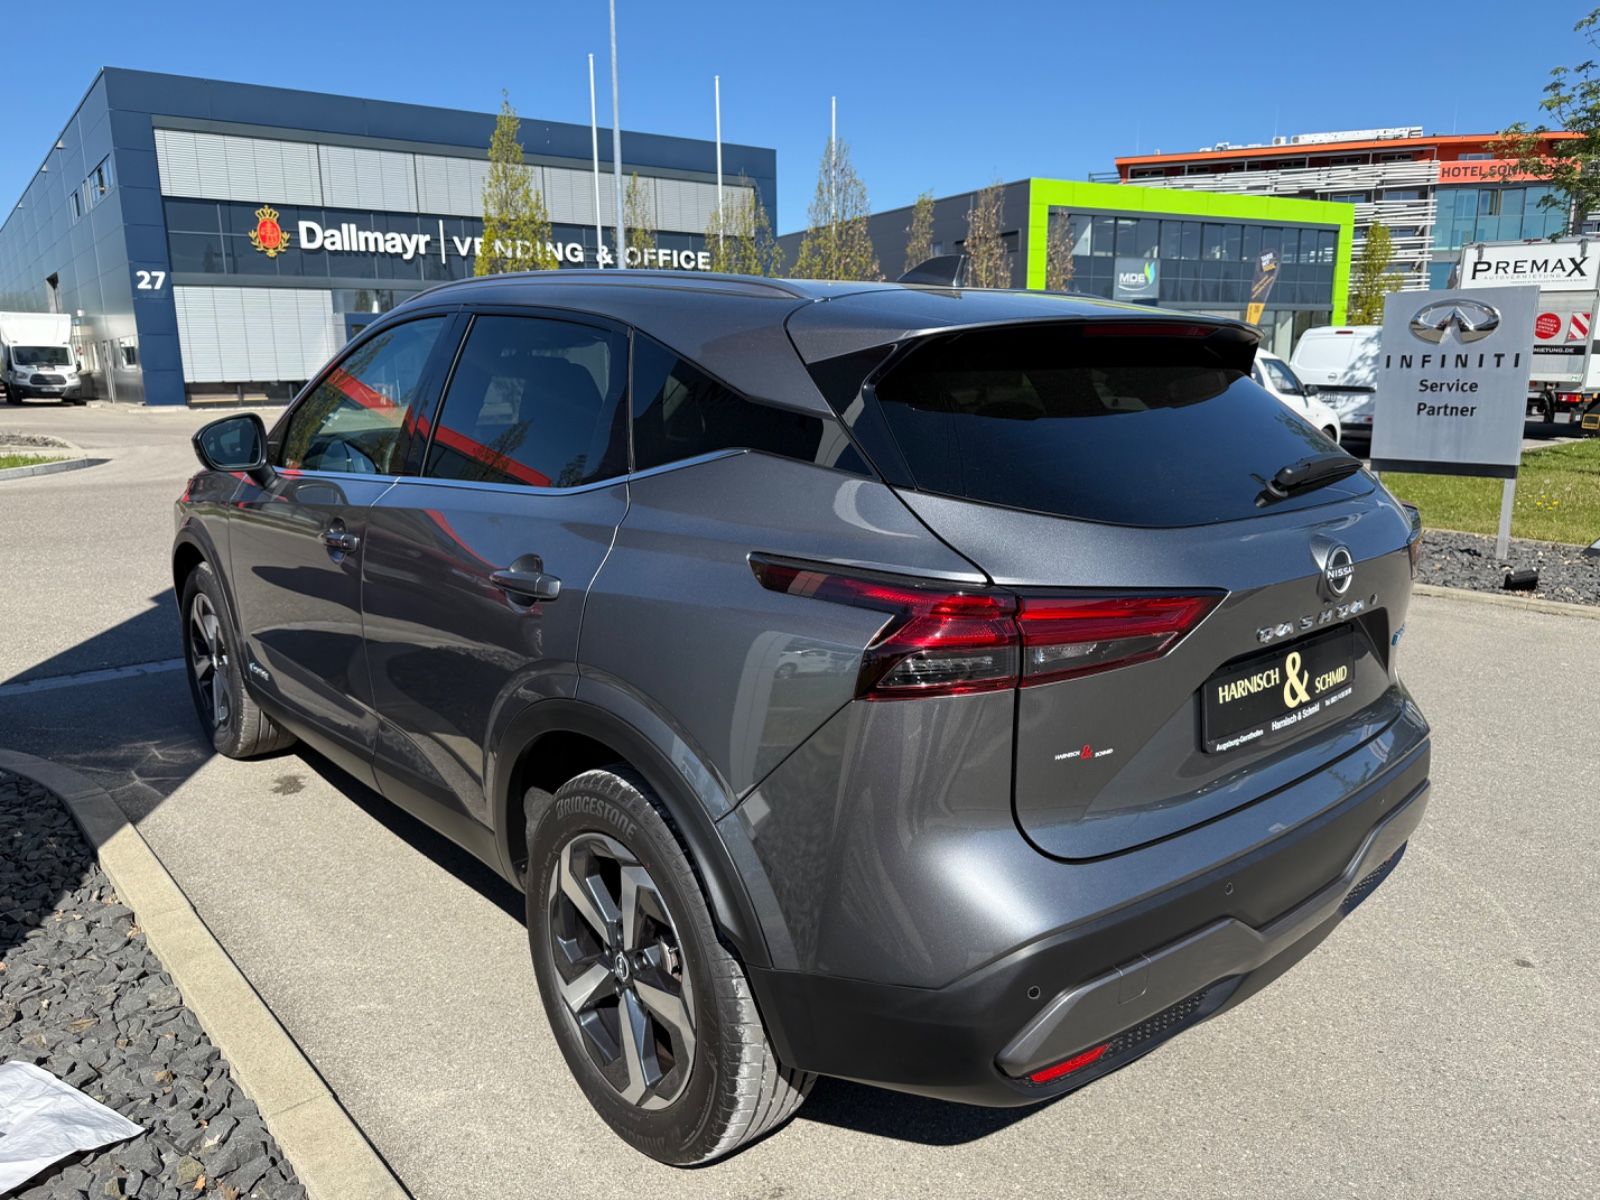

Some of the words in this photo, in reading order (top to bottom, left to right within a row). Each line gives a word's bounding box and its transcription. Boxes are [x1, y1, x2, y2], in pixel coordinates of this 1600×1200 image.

[1441, 165, 1484, 178] HOTEL
[297, 220, 430, 260] Dallmayr
[596, 245, 614, 264] &
[624, 246, 711, 269] OFFICE
[1471, 256, 1589, 280] PREMAX
[136, 270, 165, 290] 27
[1385, 353, 1520, 369] INFINITI
[1418, 379, 1478, 392] Service
[1417, 403, 1477, 416] Partner
[1218, 667, 1280, 704] HARNISCH
[1283, 651, 1311, 708] &
[1314, 665, 1348, 694] SCHMID
[556, 796, 637, 840] BRIDGESTONE
